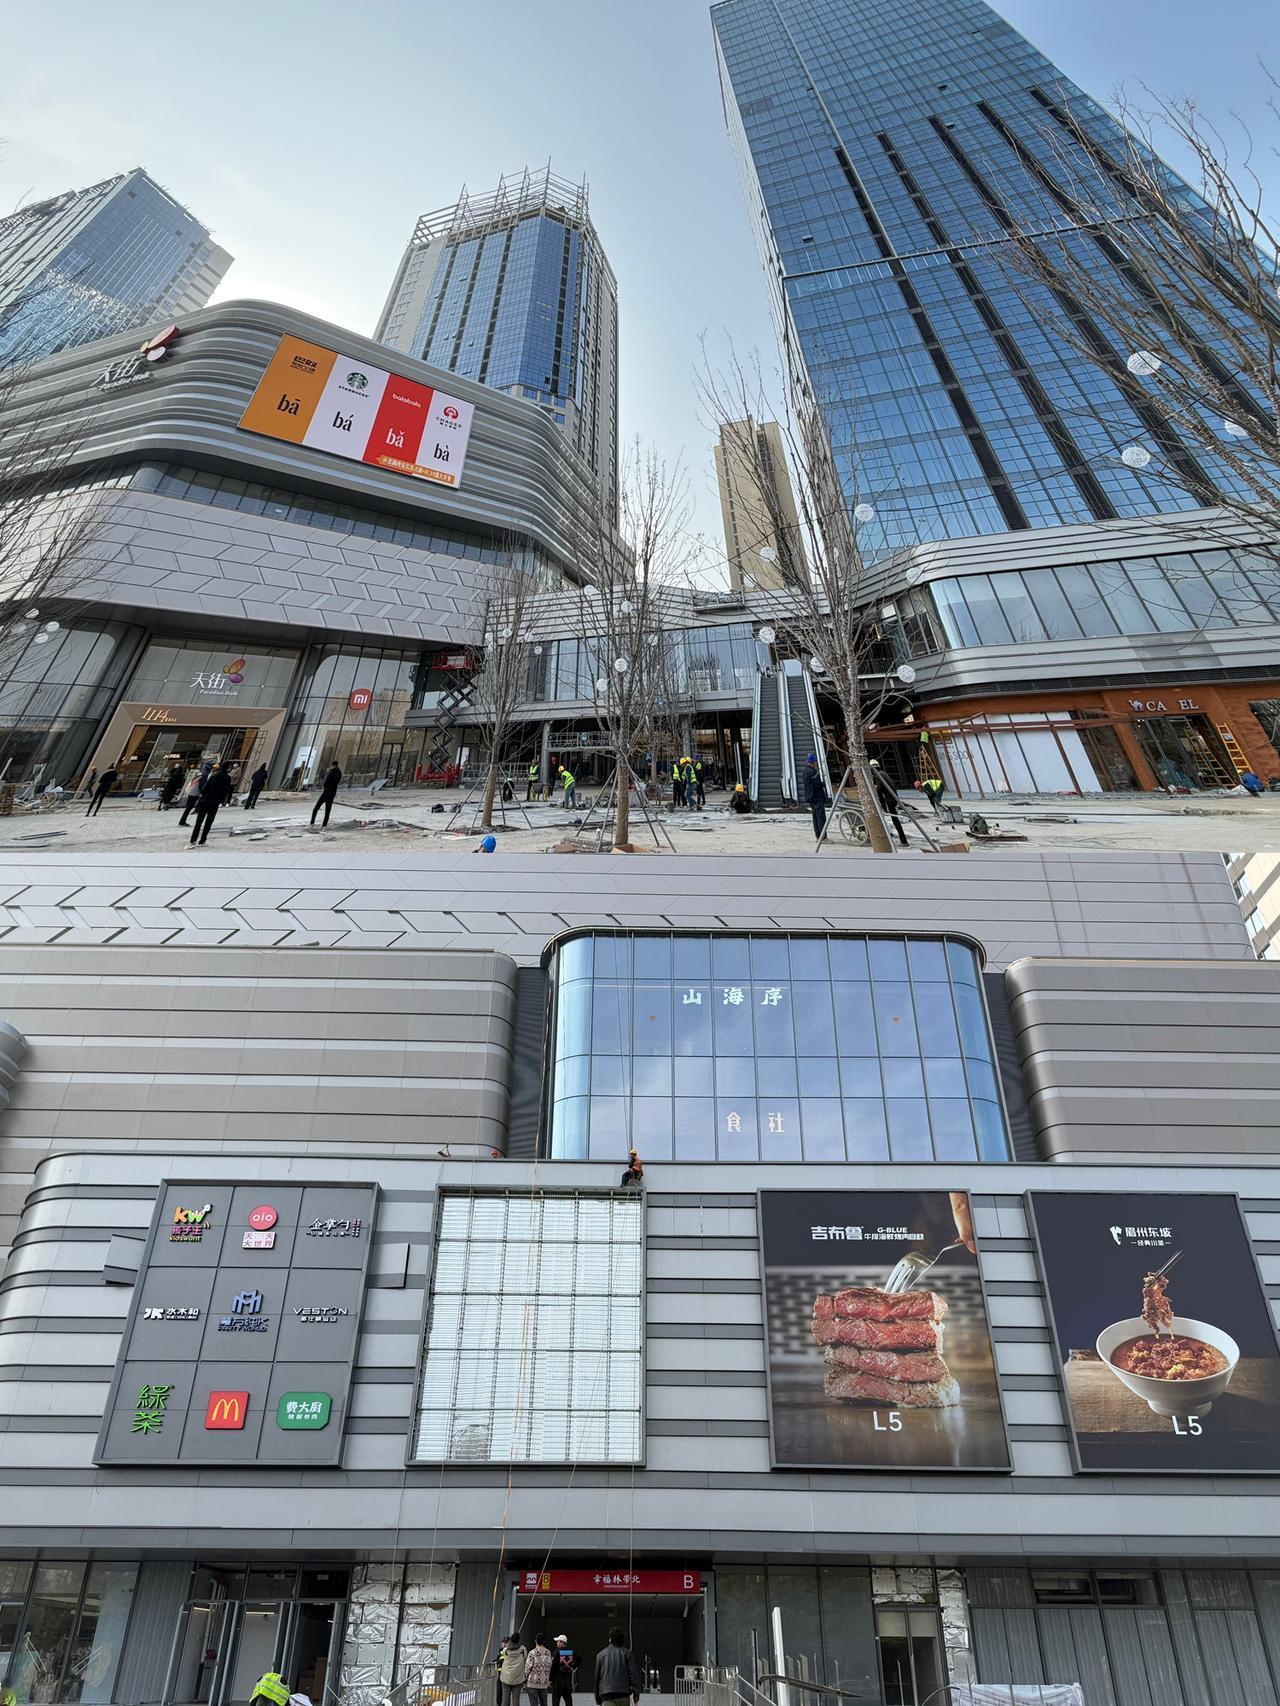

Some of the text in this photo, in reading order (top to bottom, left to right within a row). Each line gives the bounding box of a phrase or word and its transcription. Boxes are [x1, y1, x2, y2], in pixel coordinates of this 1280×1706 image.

[90, 354, 146, 387] 天街
[338, 385, 369, 398] STARBUCKS
[276, 394, 301, 416] bā
[392, 392, 422, 408] balabala
[332, 411, 354, 432] bá
[386, 428, 404, 448] bǎ
[433, 443, 450, 462] bà
[189, 671, 227, 689] 天街
[199, 688, 224, 696] Paradise
[682, 987, 783, 1007] 山海序
[726, 1111, 785, 1133] 食社
[171, 1225, 203, 1235] 孩子王
[810, 1226, 862, 1241] 吉布鲁
[1125, 1226, 1172, 1238] 眉州东坡
[169, 1235, 202, 1243] kidswant
[243, 1239, 273, 1247] 大世界
[166, 1307, 200, 1316] 水木和
[293, 1306, 348, 1316] VESTON
[286, 1401, 322, 1414] 费大厨
[872, 1410, 903, 1432] L5
[1171, 1415, 1203, 1436] L5
[592, 1574, 641, 1585] 幸福林带北
[683, 1574, 694, 1590] B
